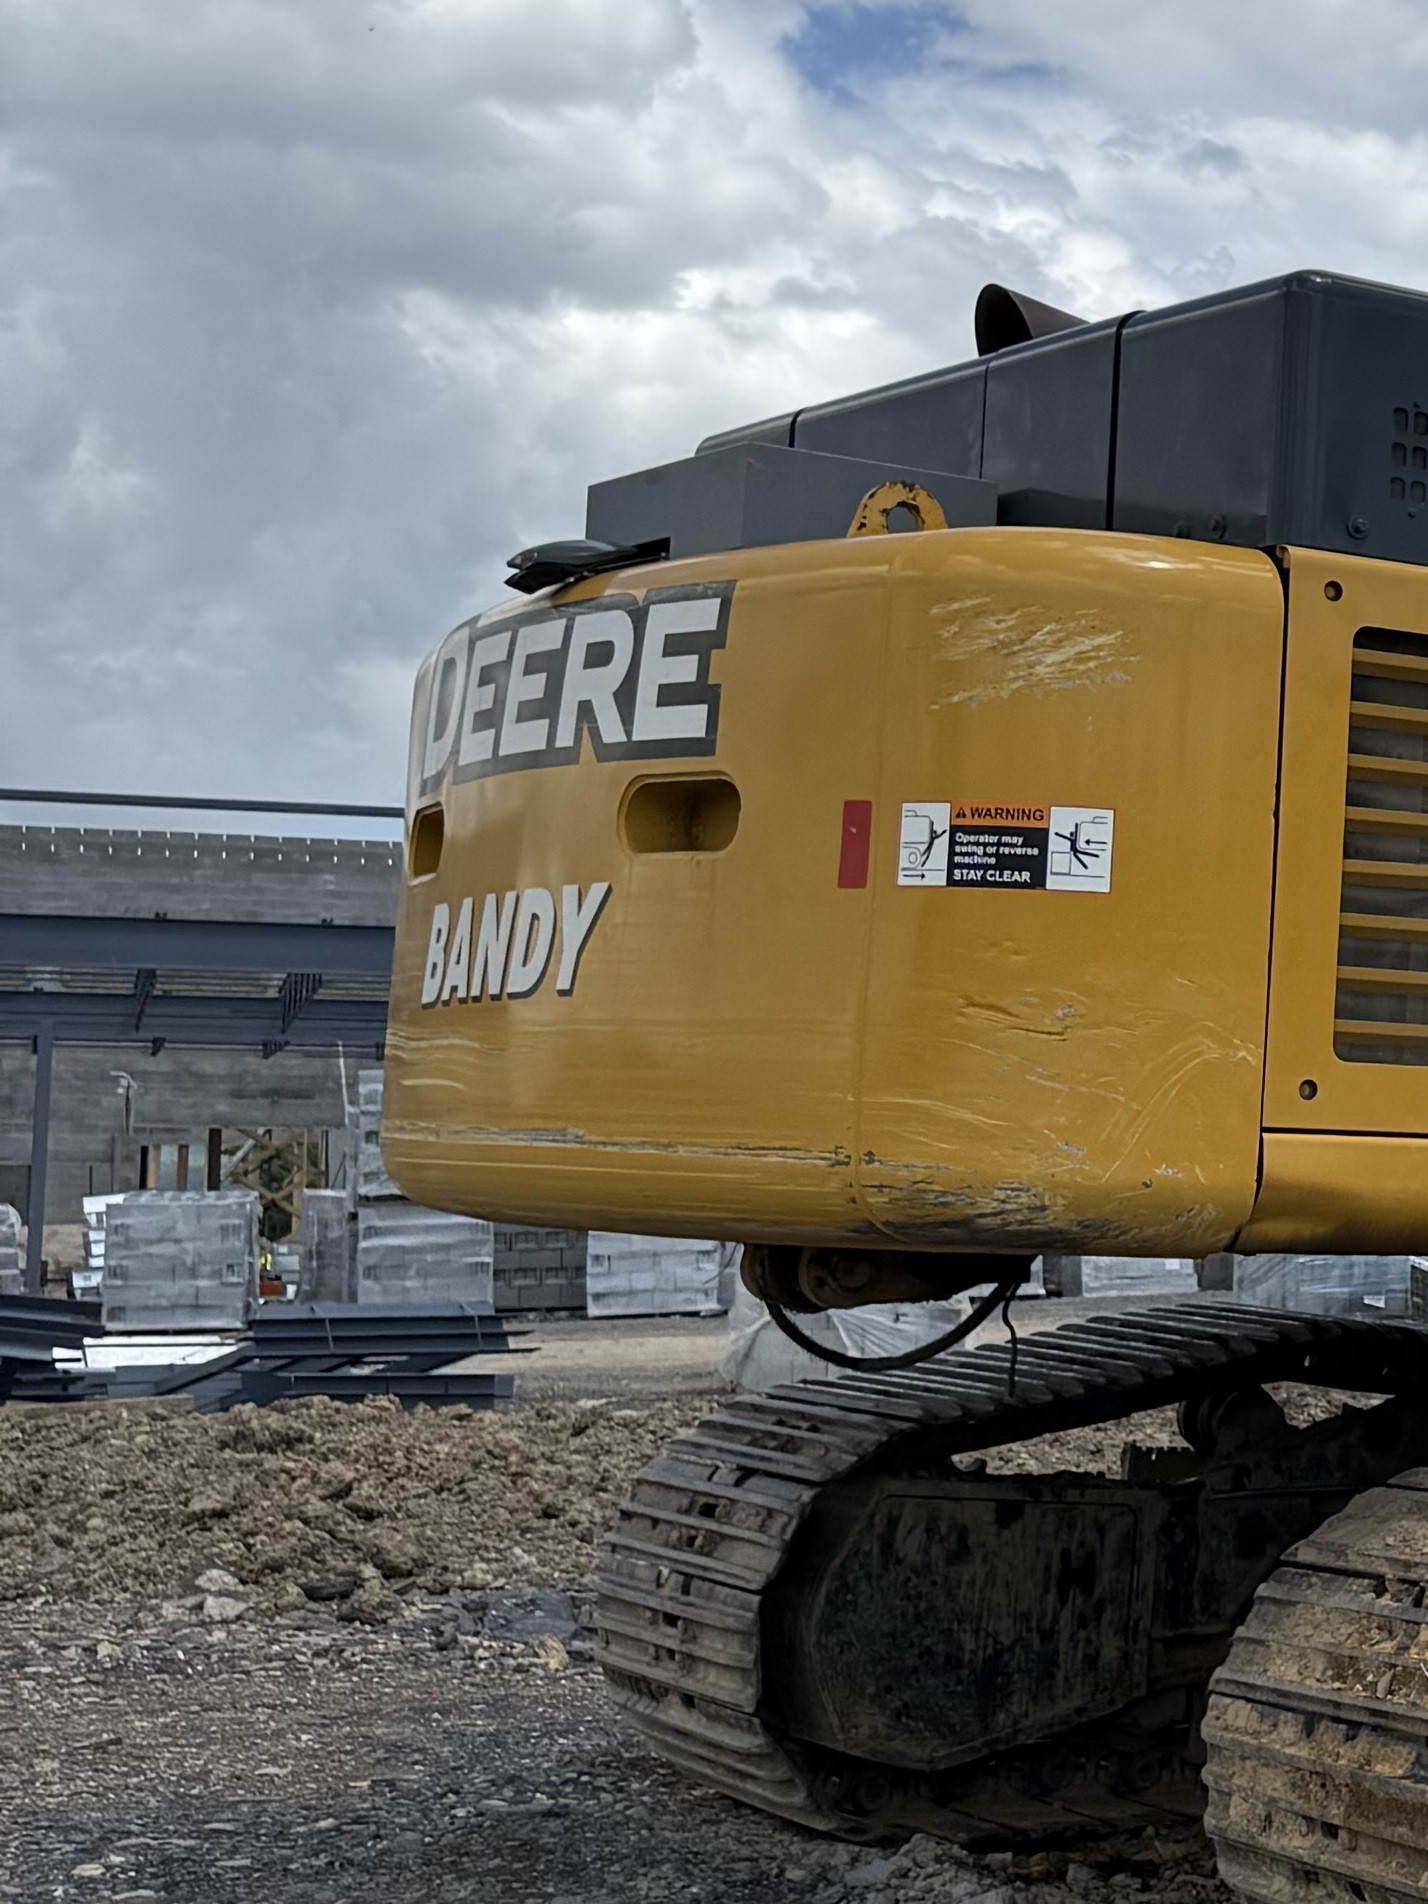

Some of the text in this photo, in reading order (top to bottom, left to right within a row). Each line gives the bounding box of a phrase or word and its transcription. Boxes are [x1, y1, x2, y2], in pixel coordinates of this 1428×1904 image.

[422, 597, 722, 780] DEERE
[970, 806, 1044, 821] WARNING
[1001, 835, 1024, 846] may
[954, 844, 1039, 856] swing or reverse
[953, 869, 1031, 883] STAY CLEAR
[421, 882, 610, 1008] BANDY
